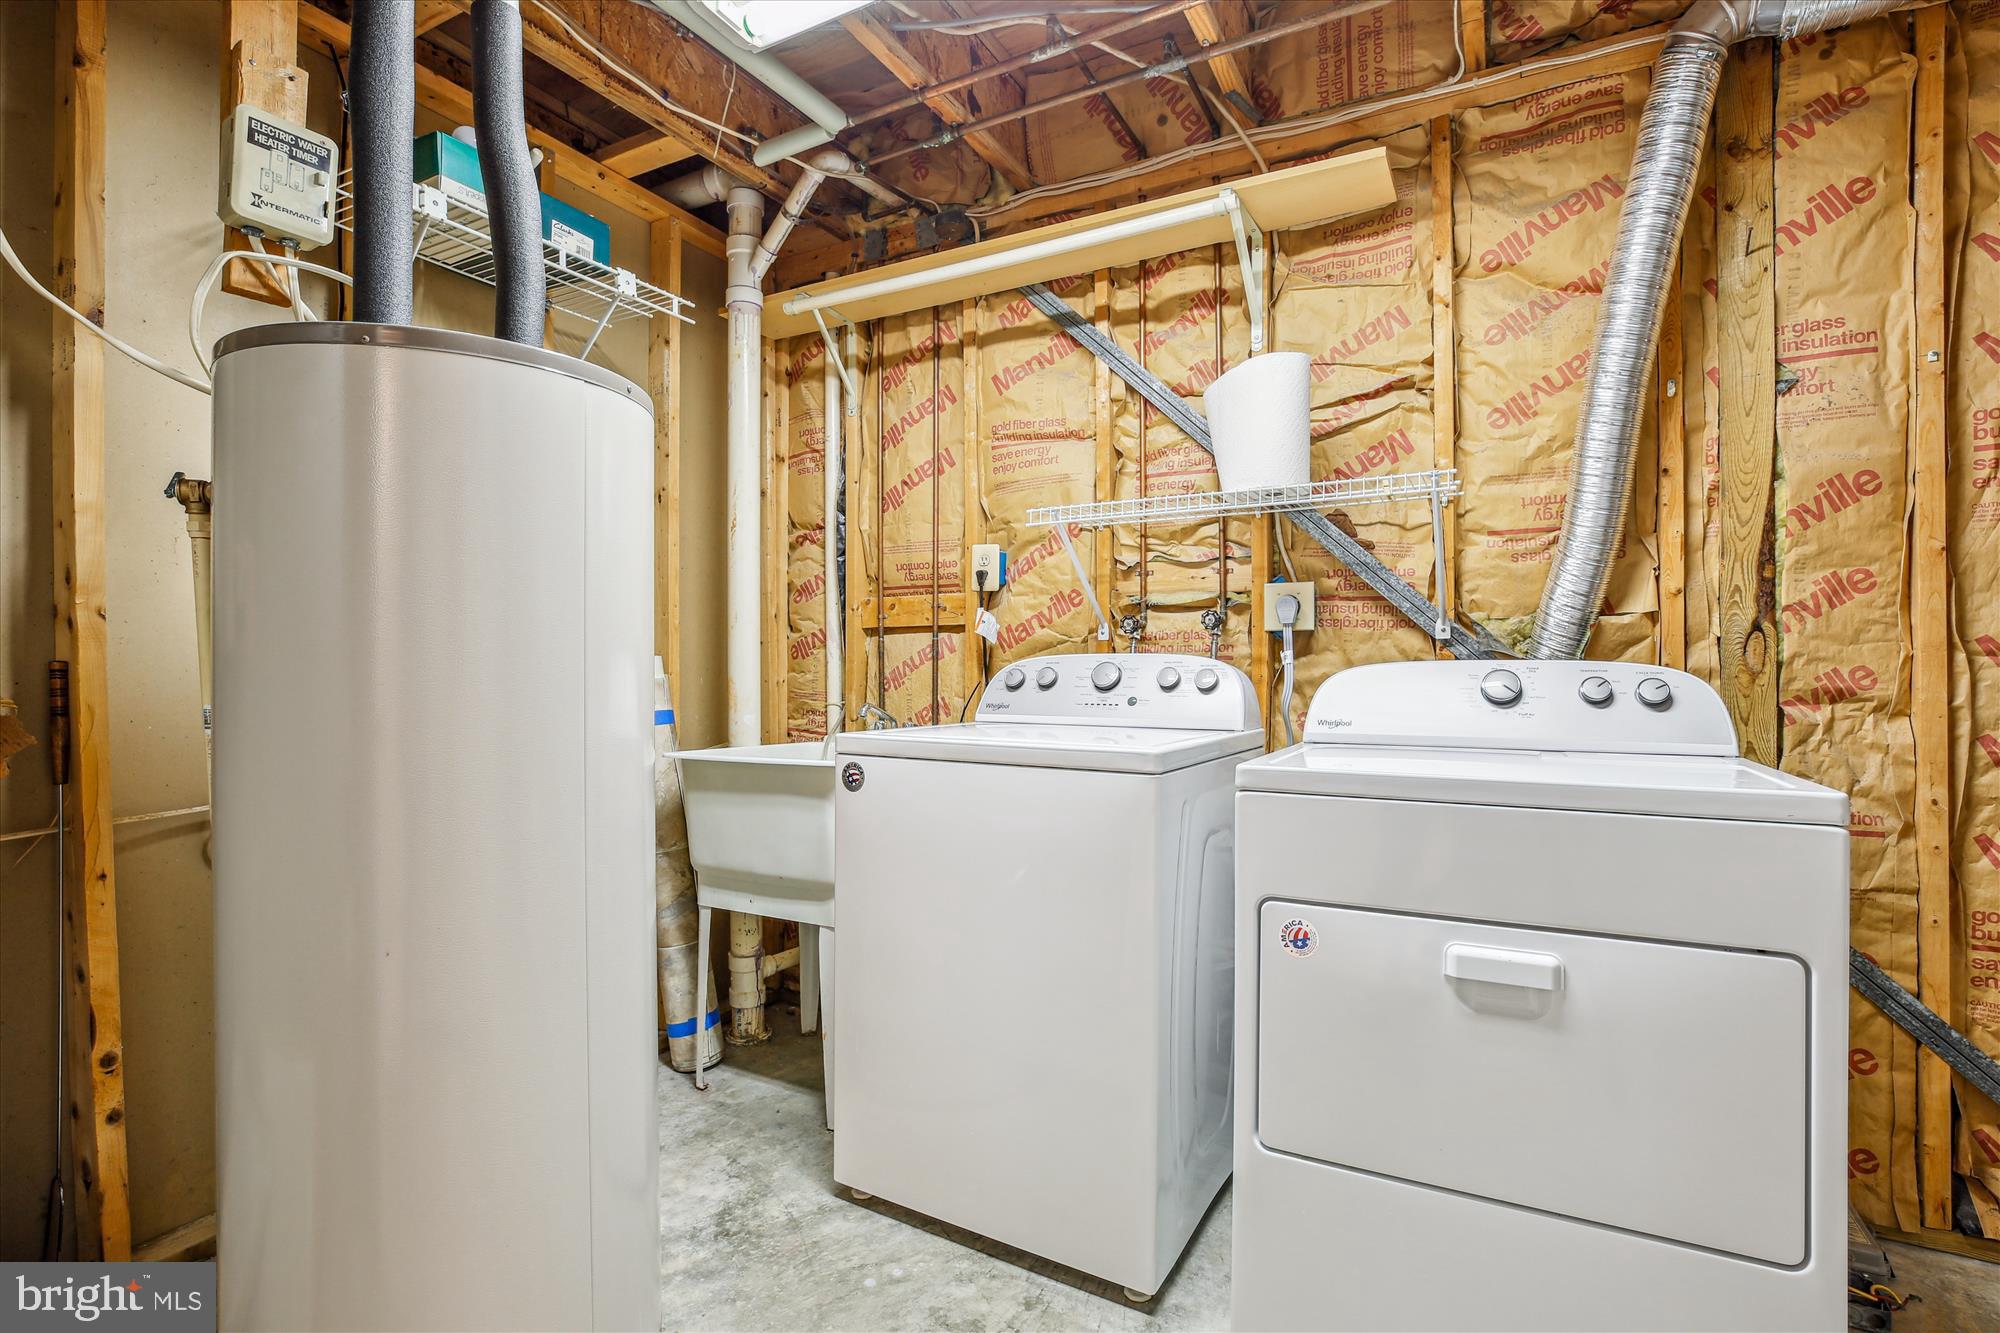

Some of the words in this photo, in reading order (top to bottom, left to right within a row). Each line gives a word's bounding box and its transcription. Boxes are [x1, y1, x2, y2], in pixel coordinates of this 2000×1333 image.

[1330, 17, 1344, 57] insula
[1370, 7, 1384, 64] comfort
[1357, 24, 1371, 73] energy
[1359, 75, 1369, 99] ave
[1371, 66, 1388, 96] njoy
[1585, 82, 1625, 101] save
[1526, 93, 1582, 121] energy
[1589, 120, 1626, 143] gold
[1776, 87, 1871, 160] nville
[251, 119, 295, 145] ELECTRIC
[297, 138, 329, 159] WATER
[1550, 127, 1586, 147] fiber
[254, 132, 290, 155] HEATER
[291, 146, 319, 166] TIMER
[250, 192, 322, 226] INTERMATIC
[1377, 206, 1413, 223] enjoy
[1776, 176, 1877, 257] nville
[1323, 220, 1376, 239] comfort
[1382, 222, 1413, 237] save
[1479, 174, 1625, 273] Manville
[1333, 231, 1380, 248] energy
[1291, 258, 1356, 273] insulation
[1358, 244, 1413, 269] building
[1384, 255, 1414, 276] gold
[1349, 266, 1383, 280] fiber
[1791, 316, 1847, 338] glass
[1310, 304, 1412, 383] Manvill
[1782, 330, 1879, 353] insulation
[1487, 349, 1593, 430] anville
[991, 419, 1012, 434] gold
[1012, 418, 1038, 429] fiber
[1038, 416, 1067, 431] glass
[1973, 407, 2000, 426] go
[1034, 427, 1086, 440] insulation
[991, 451, 1014, 463] save
[1014, 445, 1052, 458] energy
[992, 461, 1018, 476] enjoy
[1018, 454, 1060, 470] comfort
[1973, 457, 2000, 471] sa
[1156, 479, 1197, 491] energy
[1785, 469, 1883, 538] nville
[895, 562, 930, 574] comfort
[1511, 550, 1552, 564] glass
[792, 572, 826, 605] ville
[997, 588, 1084, 654] Manville
[1317, 616, 1354, 630] glass
[790, 628, 826, 661] ville
[985, 702, 1010, 712] Whirlpool
[1779, 664, 1879, 728] nville
[1317, 718, 1352, 730] Whirlpool
[1971, 911, 2000, 926] go
[1280, 919, 1304, 948] AMERICA
